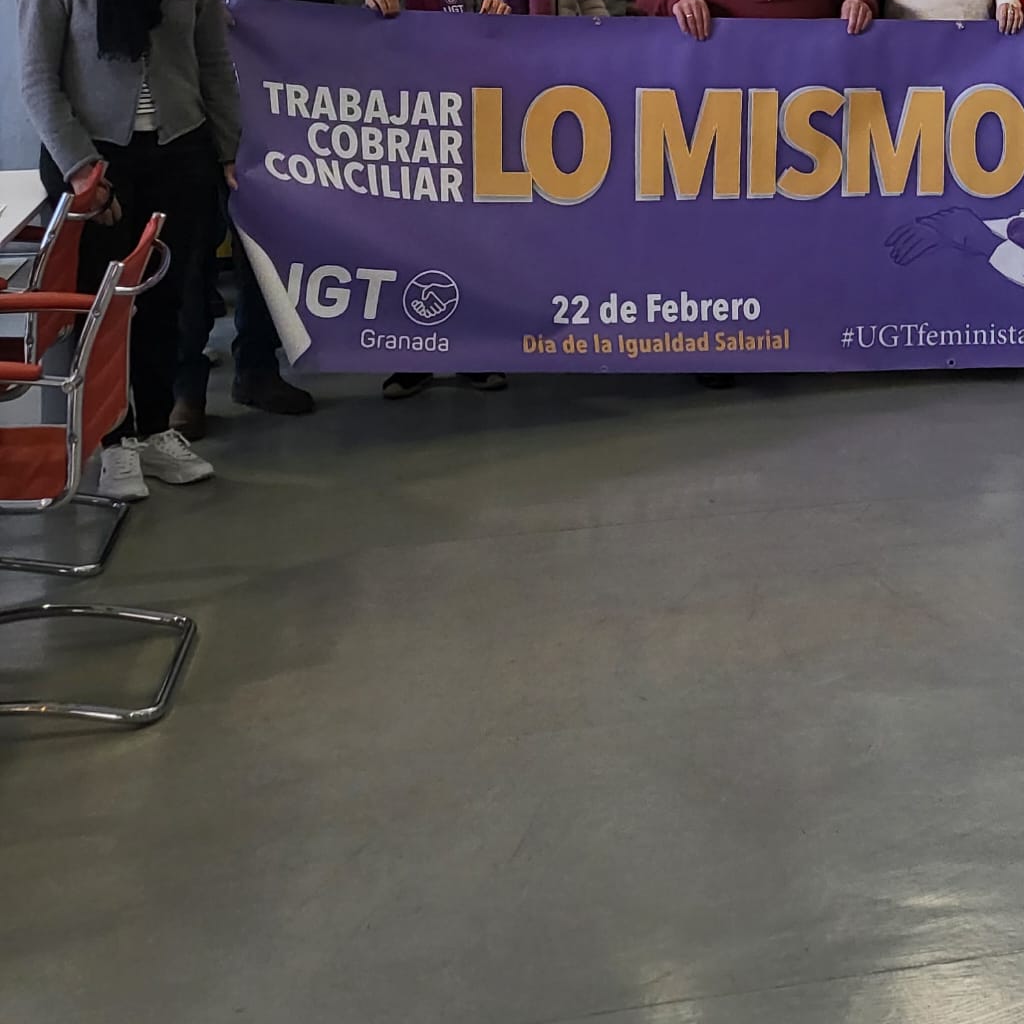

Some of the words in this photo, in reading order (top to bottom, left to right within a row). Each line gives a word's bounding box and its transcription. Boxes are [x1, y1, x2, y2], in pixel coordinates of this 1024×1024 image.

[262, 80, 464, 127] TRABAJAR
[307, 122, 464, 165] COBRAR
[471, 84, 612, 206] LO
[264, 150, 464, 203] CONCILIAR
[551, 294, 590, 325] 22
[599, 292, 638, 324] de
[646, 291, 761, 323] Febrero
[360, 328, 449, 352] Granada
[562, 333, 588, 354] de
[593, 333, 612, 354] la
[618, 331, 710, 359] Igualdad
[715, 328, 790, 352] Salarial
